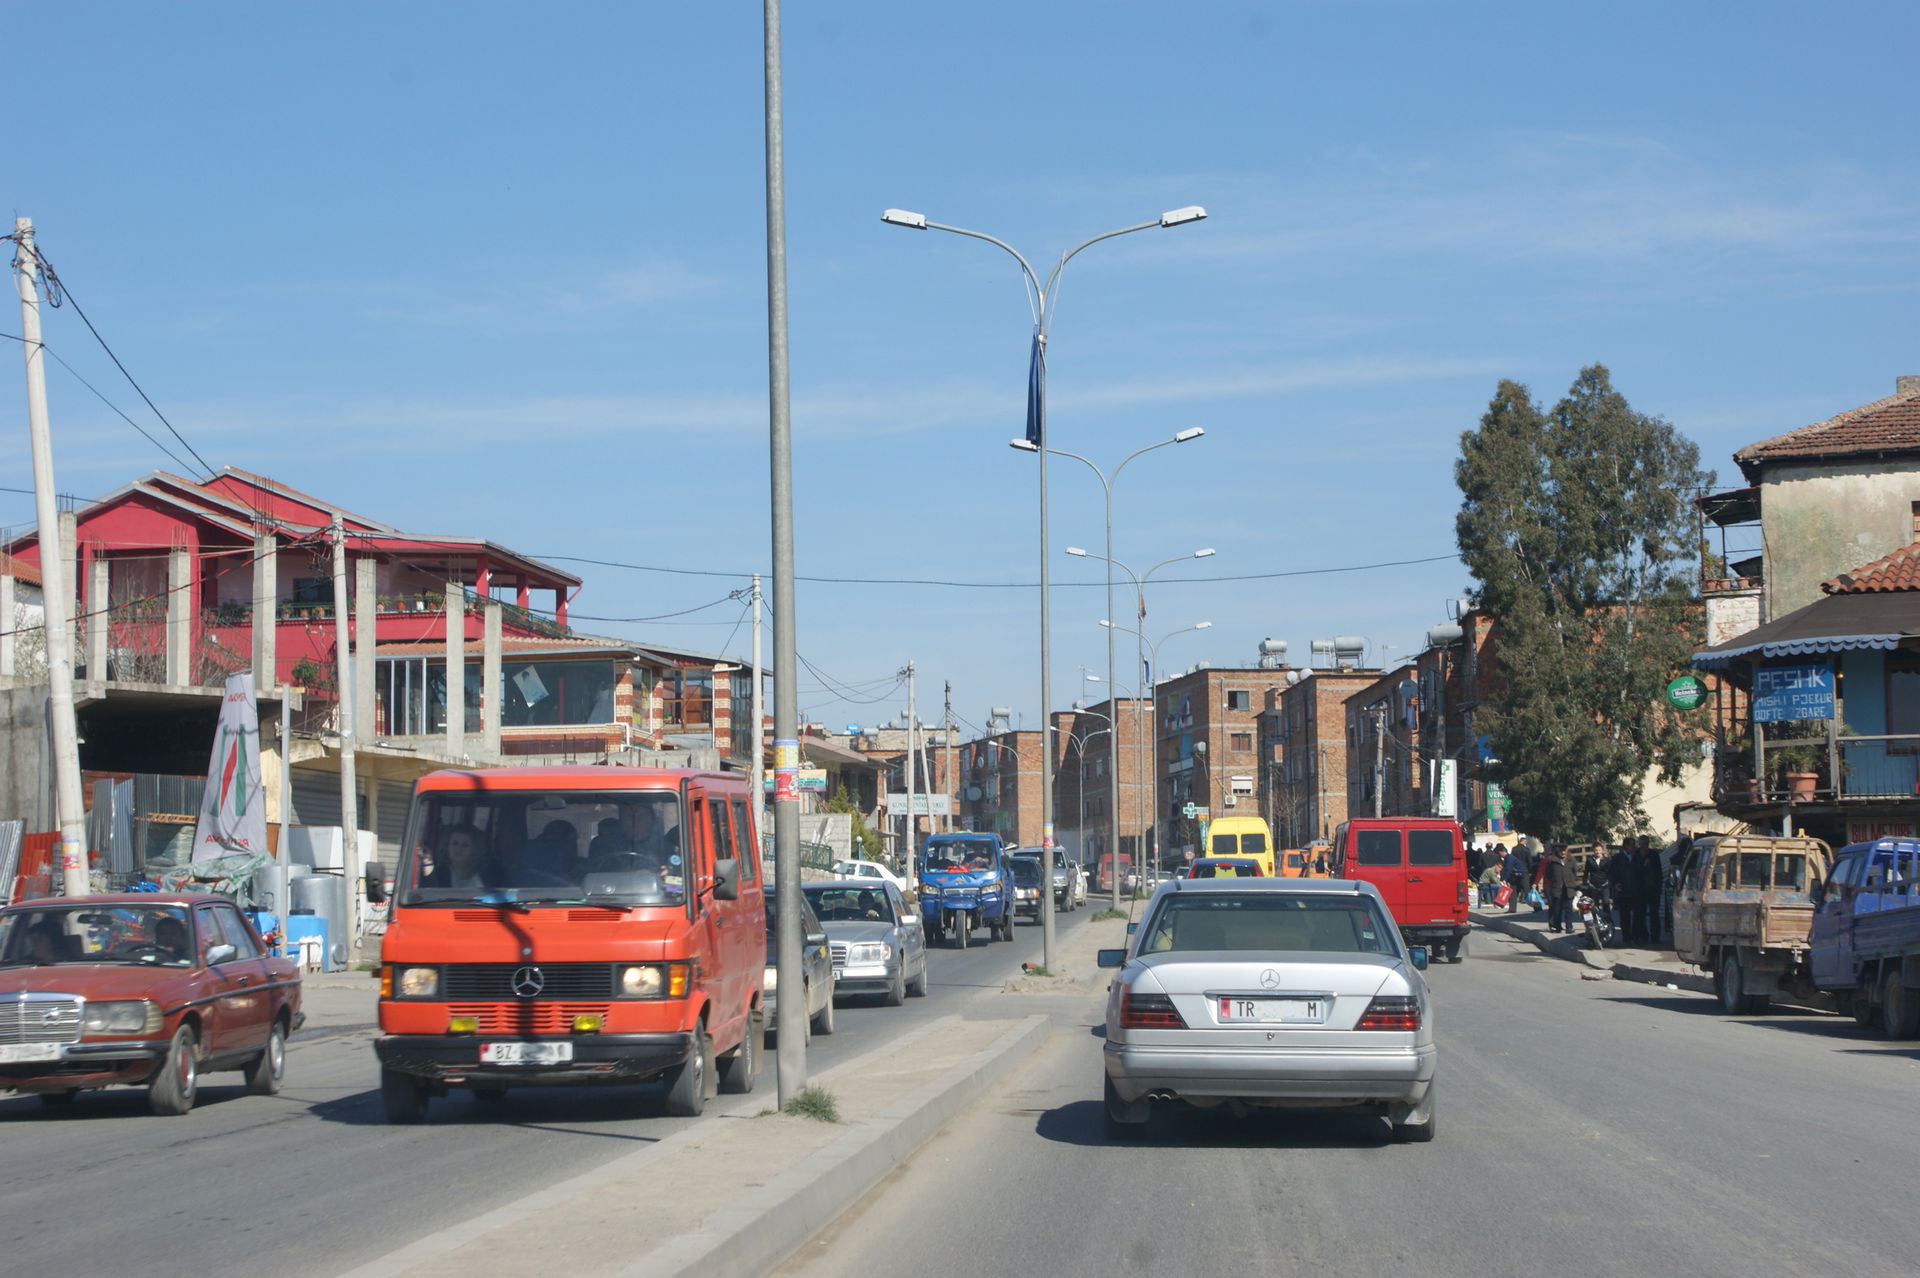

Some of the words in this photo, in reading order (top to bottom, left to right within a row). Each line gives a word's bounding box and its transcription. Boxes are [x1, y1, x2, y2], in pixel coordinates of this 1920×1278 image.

[1758, 667, 1826, 689] PESHK
[1237, 1001, 1255, 1017] TR
[1307, 1002, 1317, 1018] M
[496, 1045, 513, 1060] BZ
